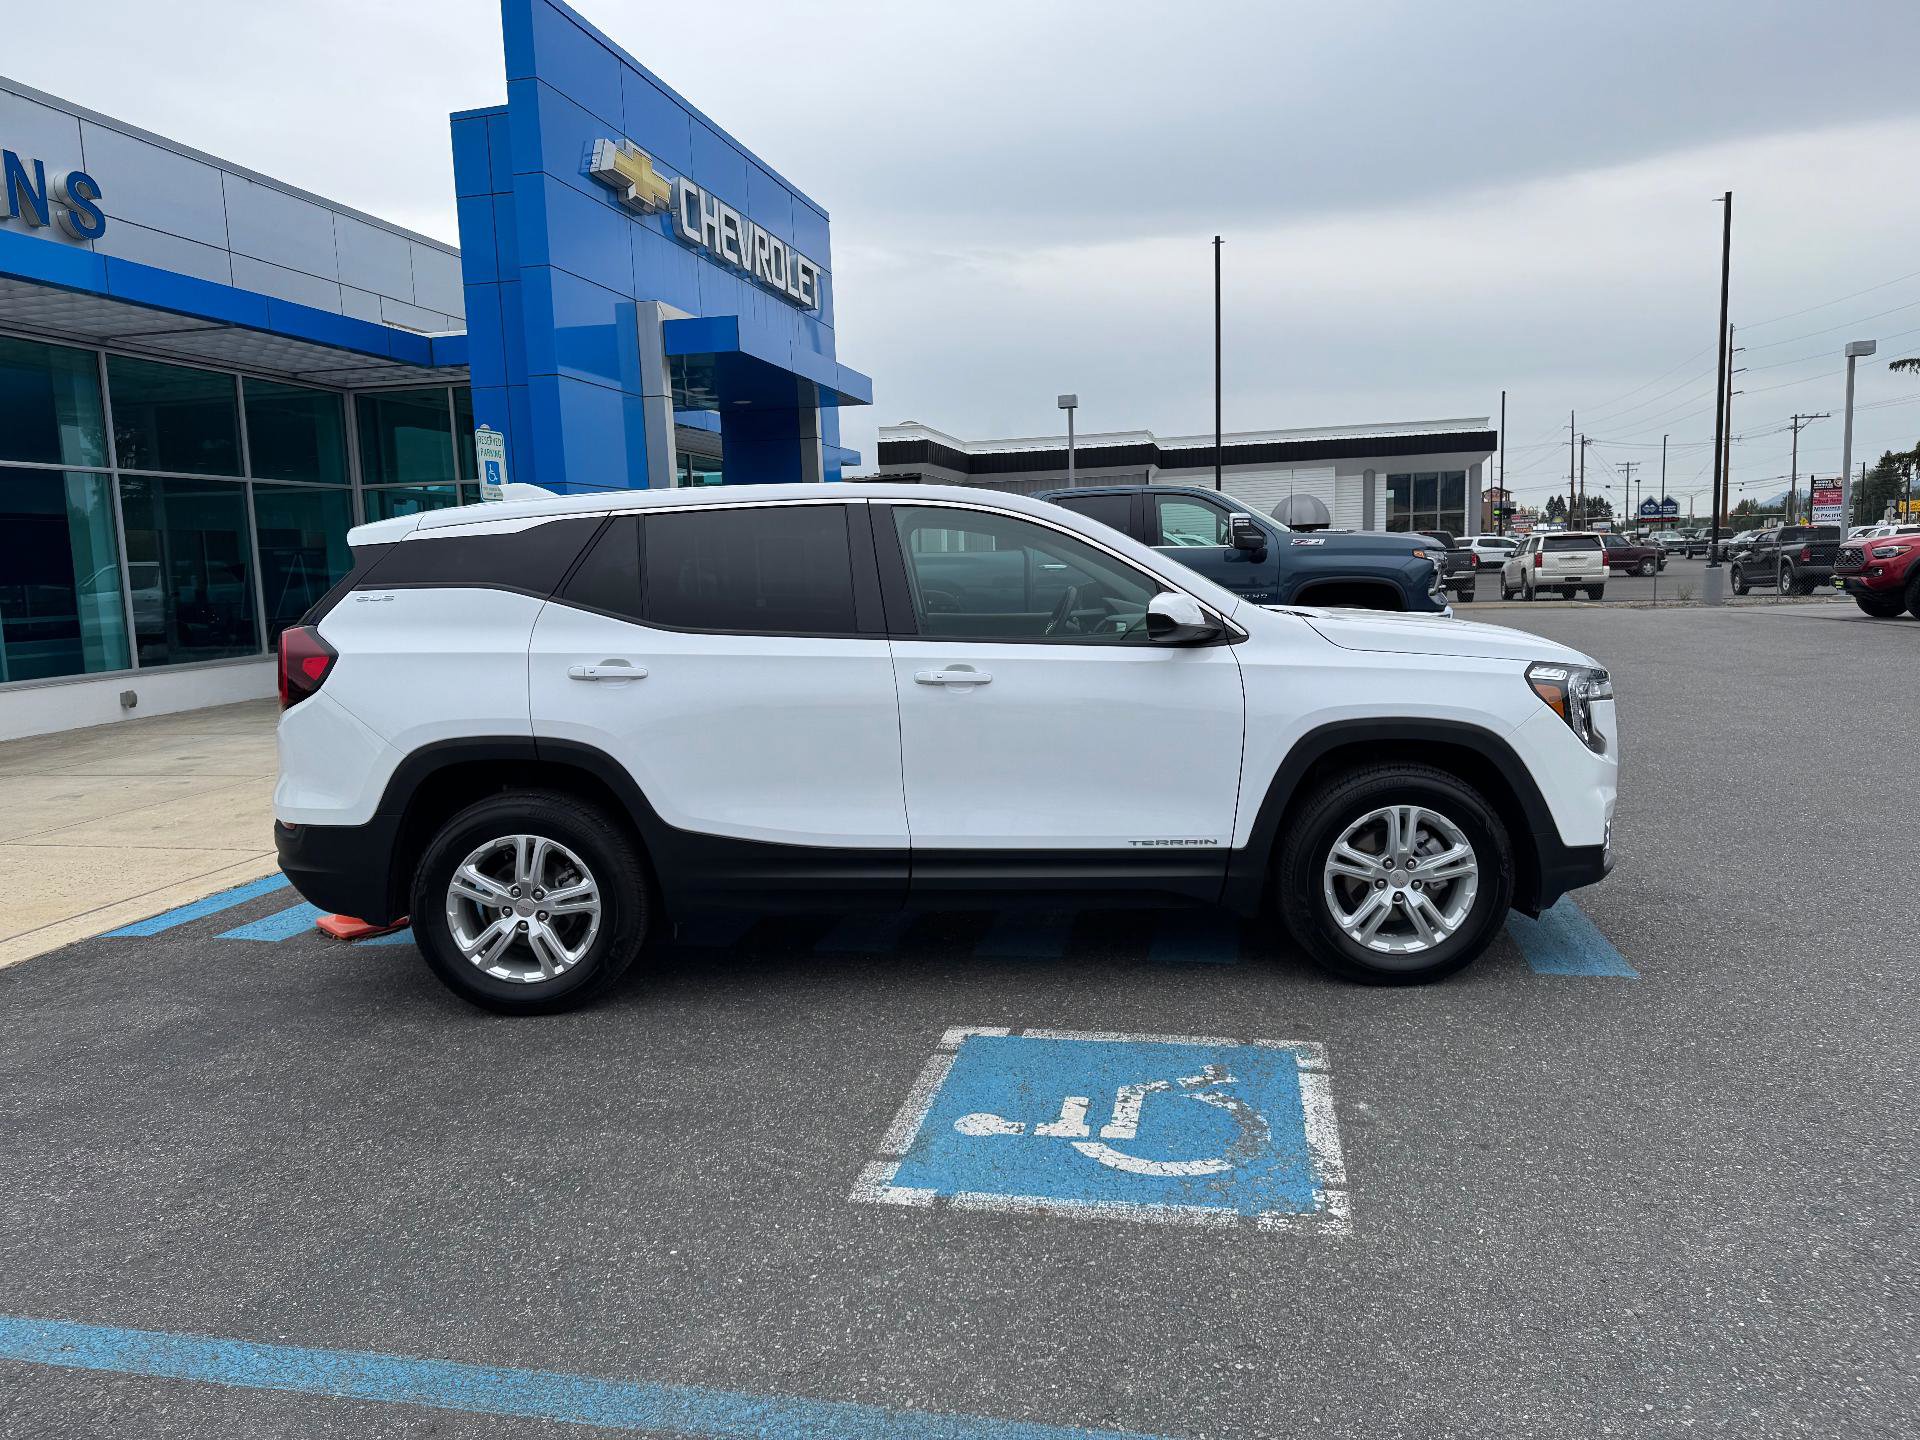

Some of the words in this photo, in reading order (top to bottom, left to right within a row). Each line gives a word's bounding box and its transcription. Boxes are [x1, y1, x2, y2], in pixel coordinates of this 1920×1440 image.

[672, 177, 821, 310] CHEVROLET
[478, 434, 502, 447] RESERVED
[480, 447, 502, 459] PARKING
[1128, 838, 1218, 847] TERRAIN
